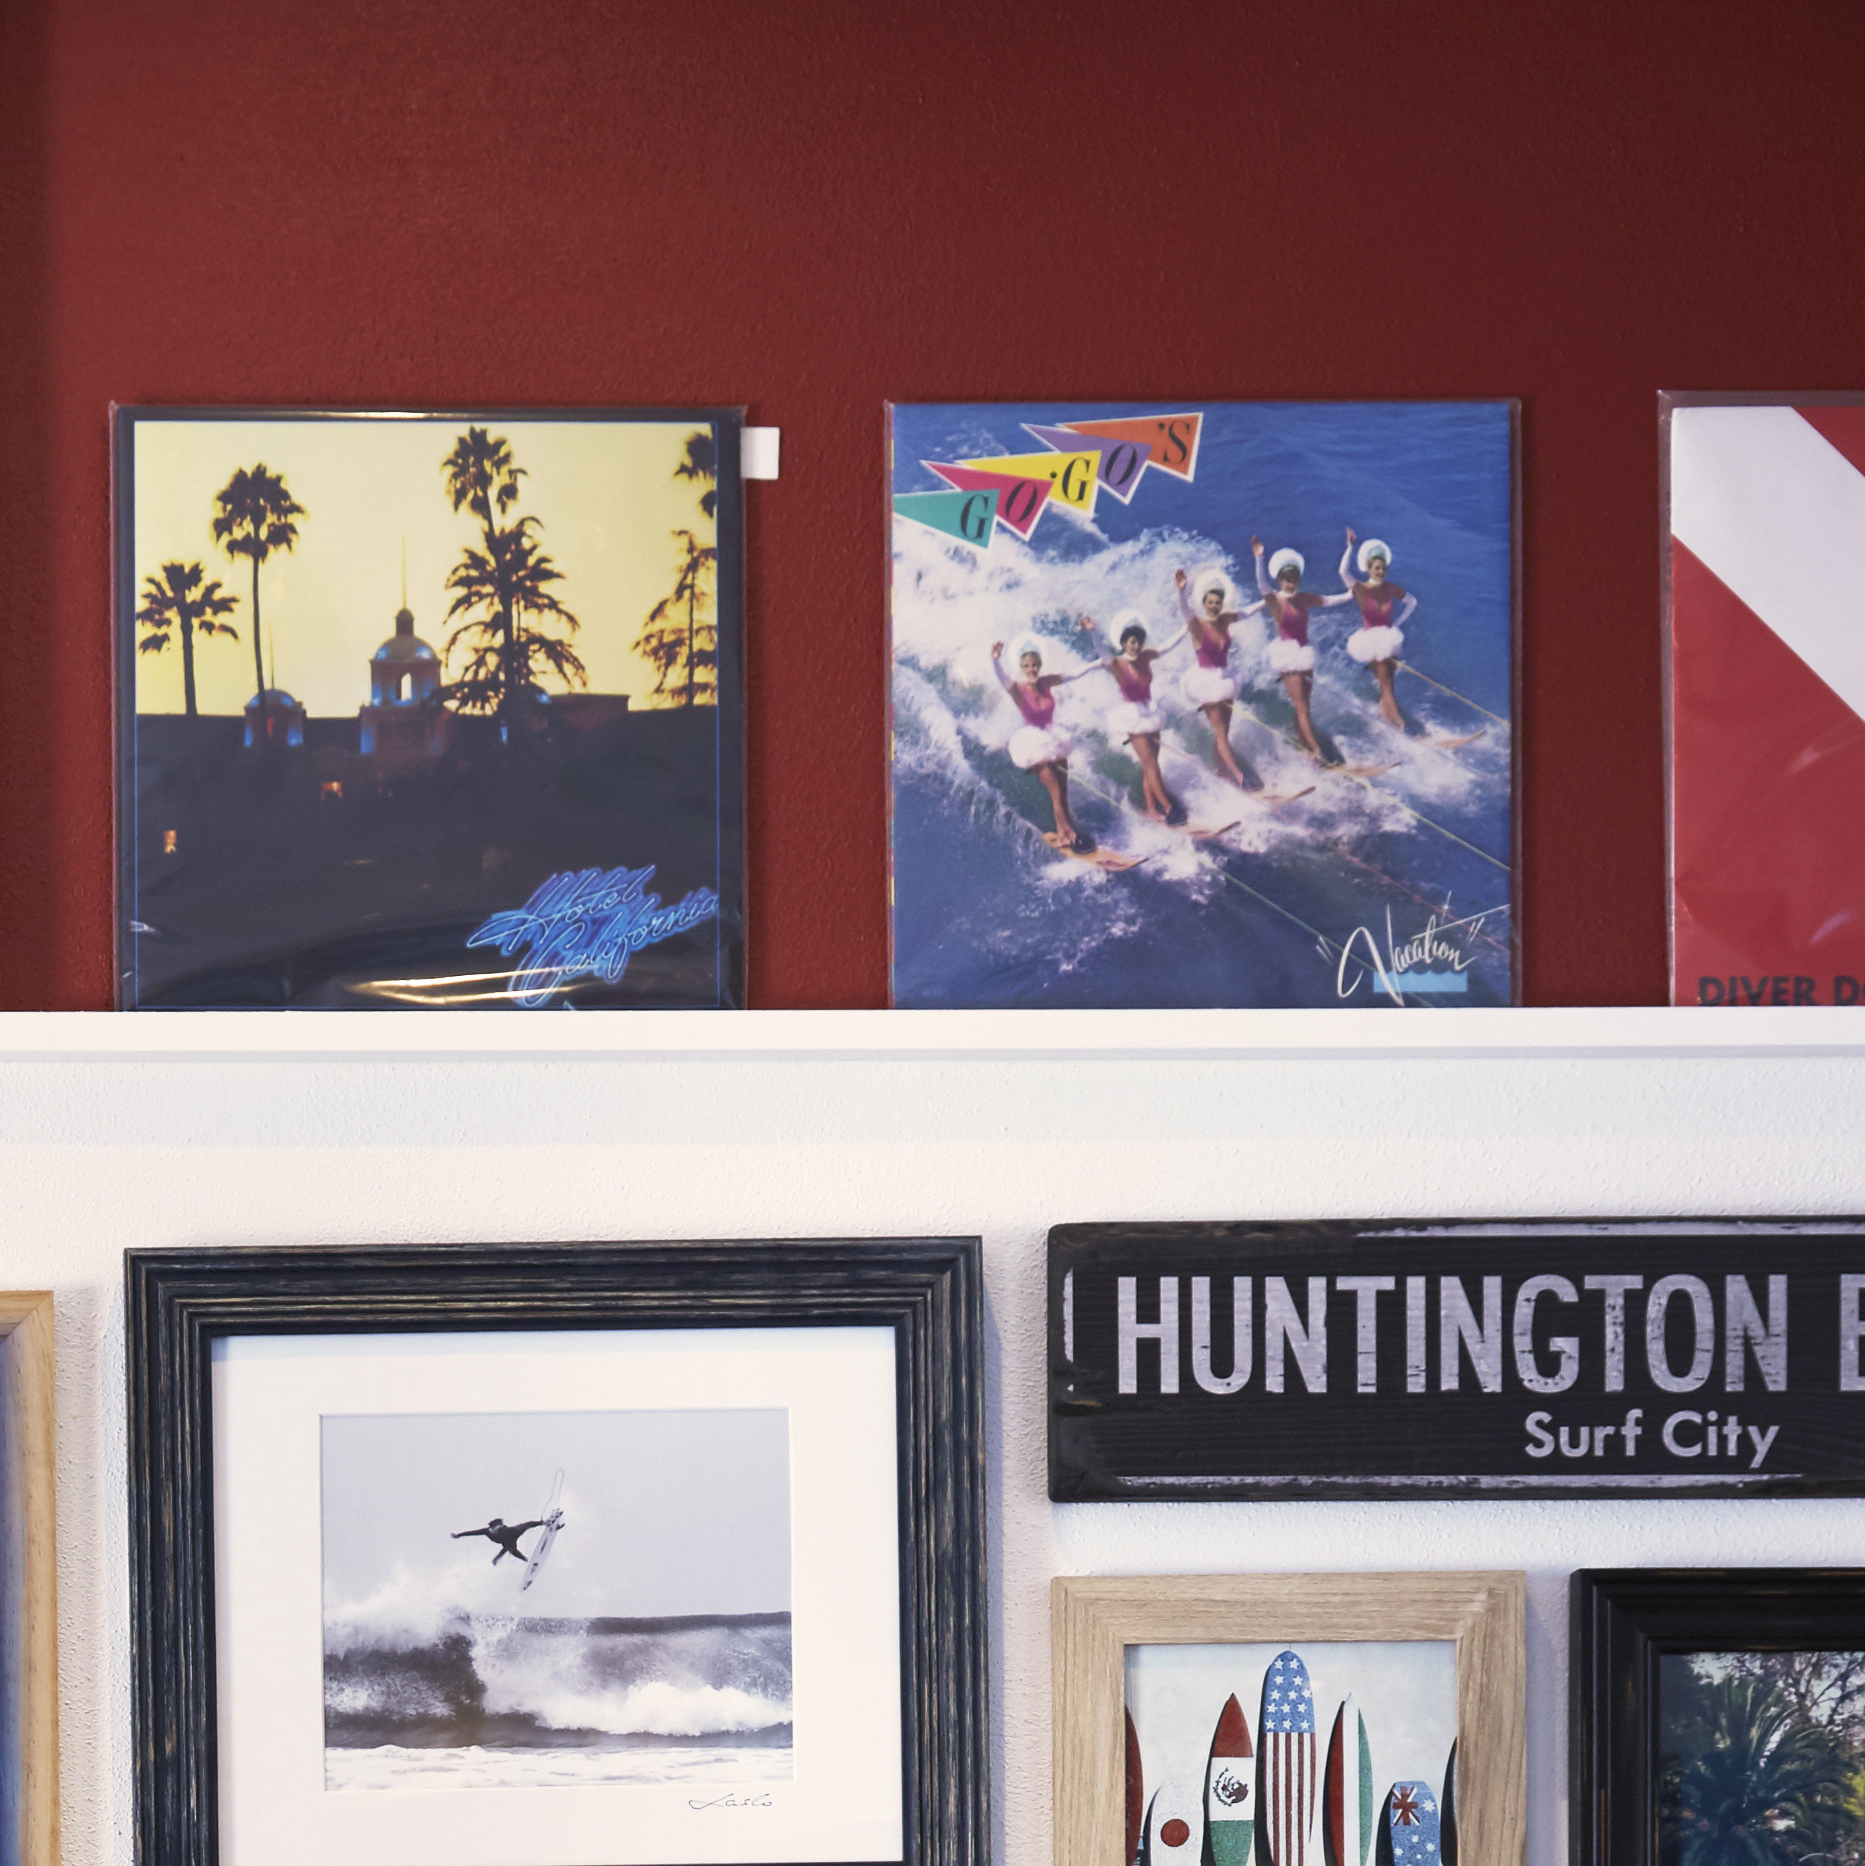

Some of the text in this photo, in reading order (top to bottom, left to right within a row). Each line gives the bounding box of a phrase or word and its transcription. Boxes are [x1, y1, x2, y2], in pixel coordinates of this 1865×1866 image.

[466, 864, 655, 951] Hotel
[509, 891, 719, 1008] California
[1698, 976, 1817, 1007] DIVER
[1117, 1273, 1789, 1395] HUNTINGTON
[1524, 1408, 1781, 1469] Surf City
